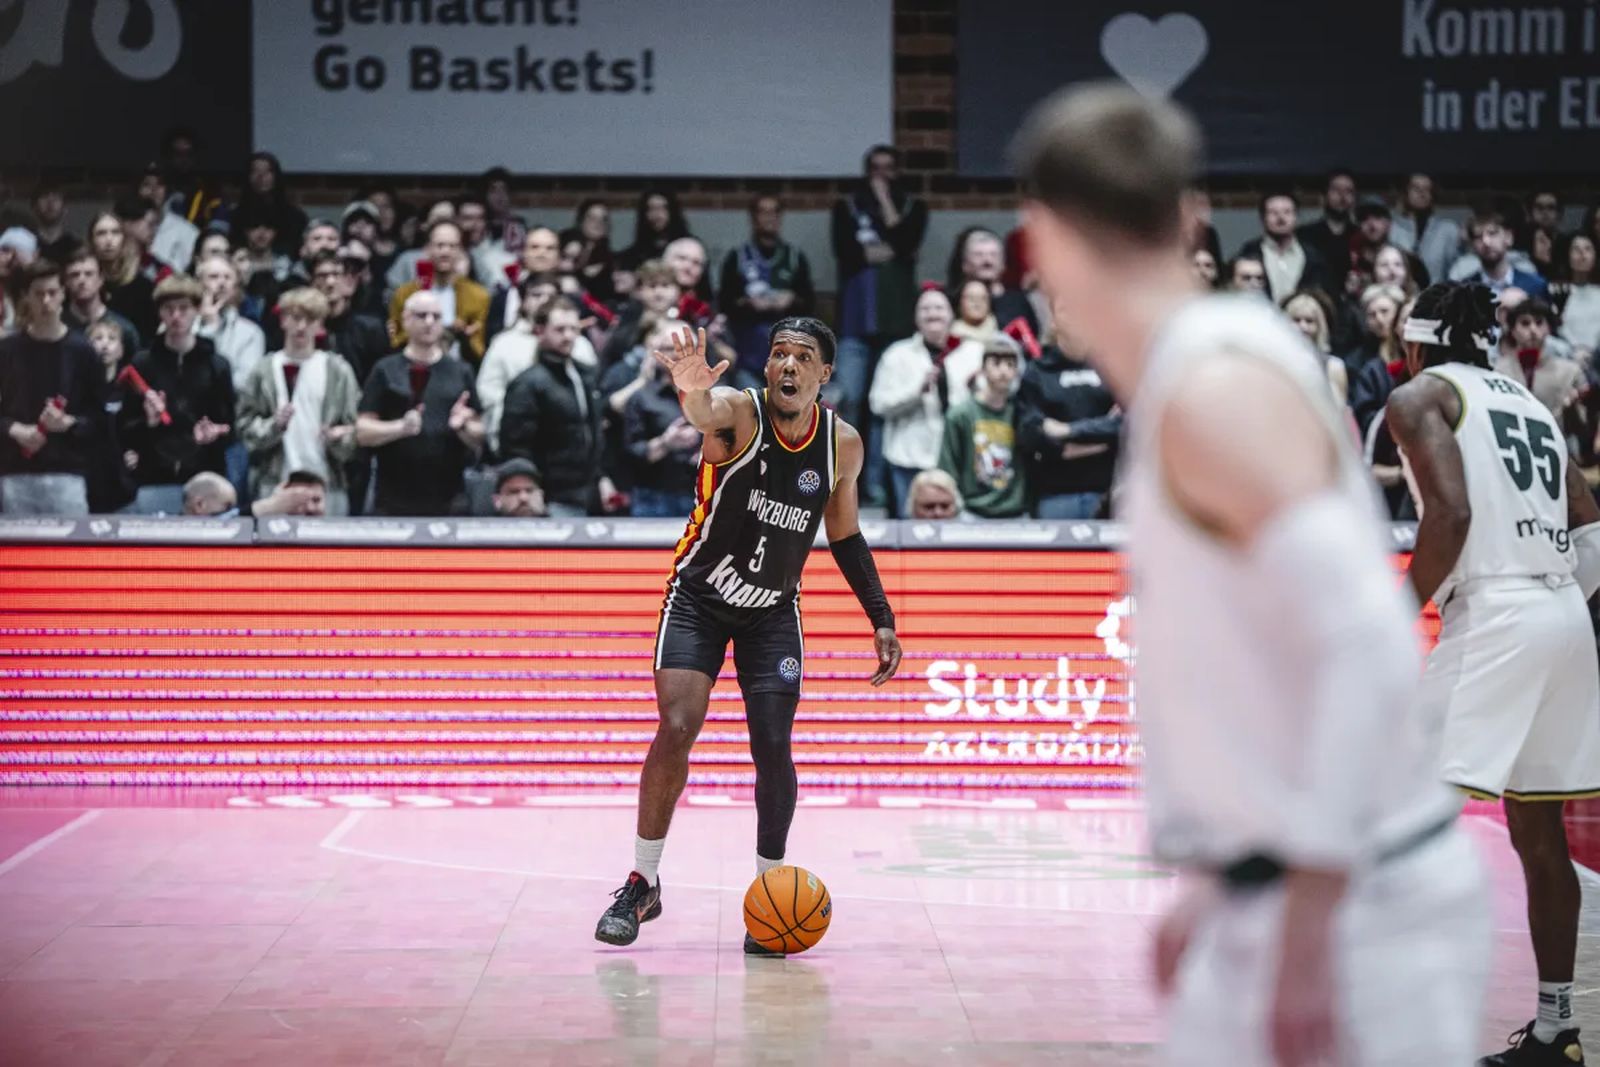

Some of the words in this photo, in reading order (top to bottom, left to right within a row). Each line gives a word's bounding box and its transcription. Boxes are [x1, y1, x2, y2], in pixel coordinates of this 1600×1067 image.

[1402, 0, 1565, 57] Komm
[313, 44, 386, 91] Go
[409, 44, 655, 94] Baskets!
[1422, 78, 1462, 131] in
[1475, 77, 1546, 131] der
[1488, 409, 1561, 501] 55
[705, 553, 782, 608] KNAUF
[748, 536, 768, 573] 5
[925, 656, 1106, 730] Study
